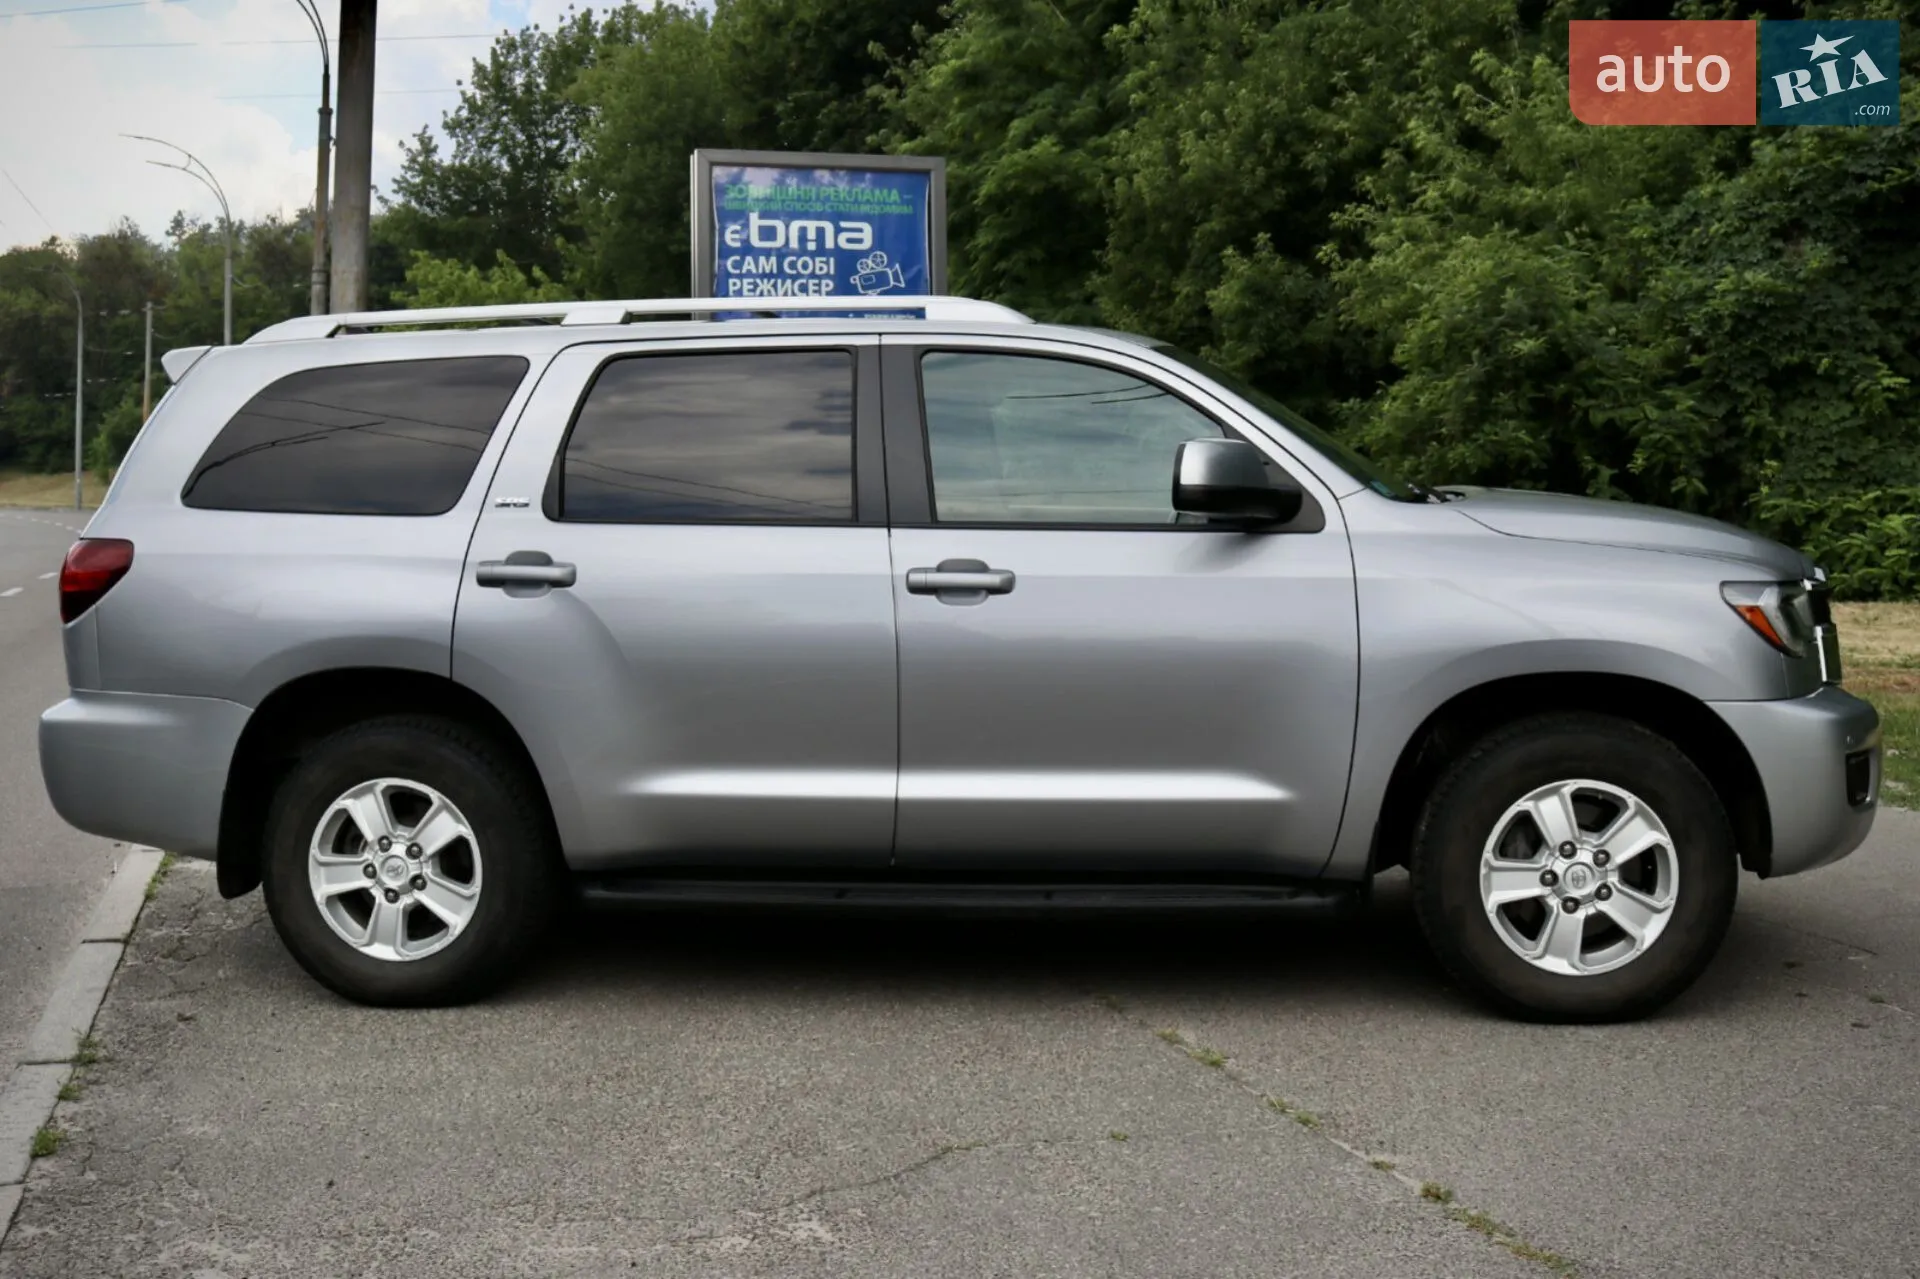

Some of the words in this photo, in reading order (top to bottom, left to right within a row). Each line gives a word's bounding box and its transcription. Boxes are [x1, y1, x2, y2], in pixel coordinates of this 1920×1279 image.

[725, 183, 816, 201] ЗОВНІШНЯ
[819, 186, 900, 204] РЕКЛАМА
[749, 211, 873, 250] bma
[726, 255, 777, 275] САМ
[783, 256, 836, 275] СОБІ
[728, 278, 835, 297] РЕЖИСЕР
